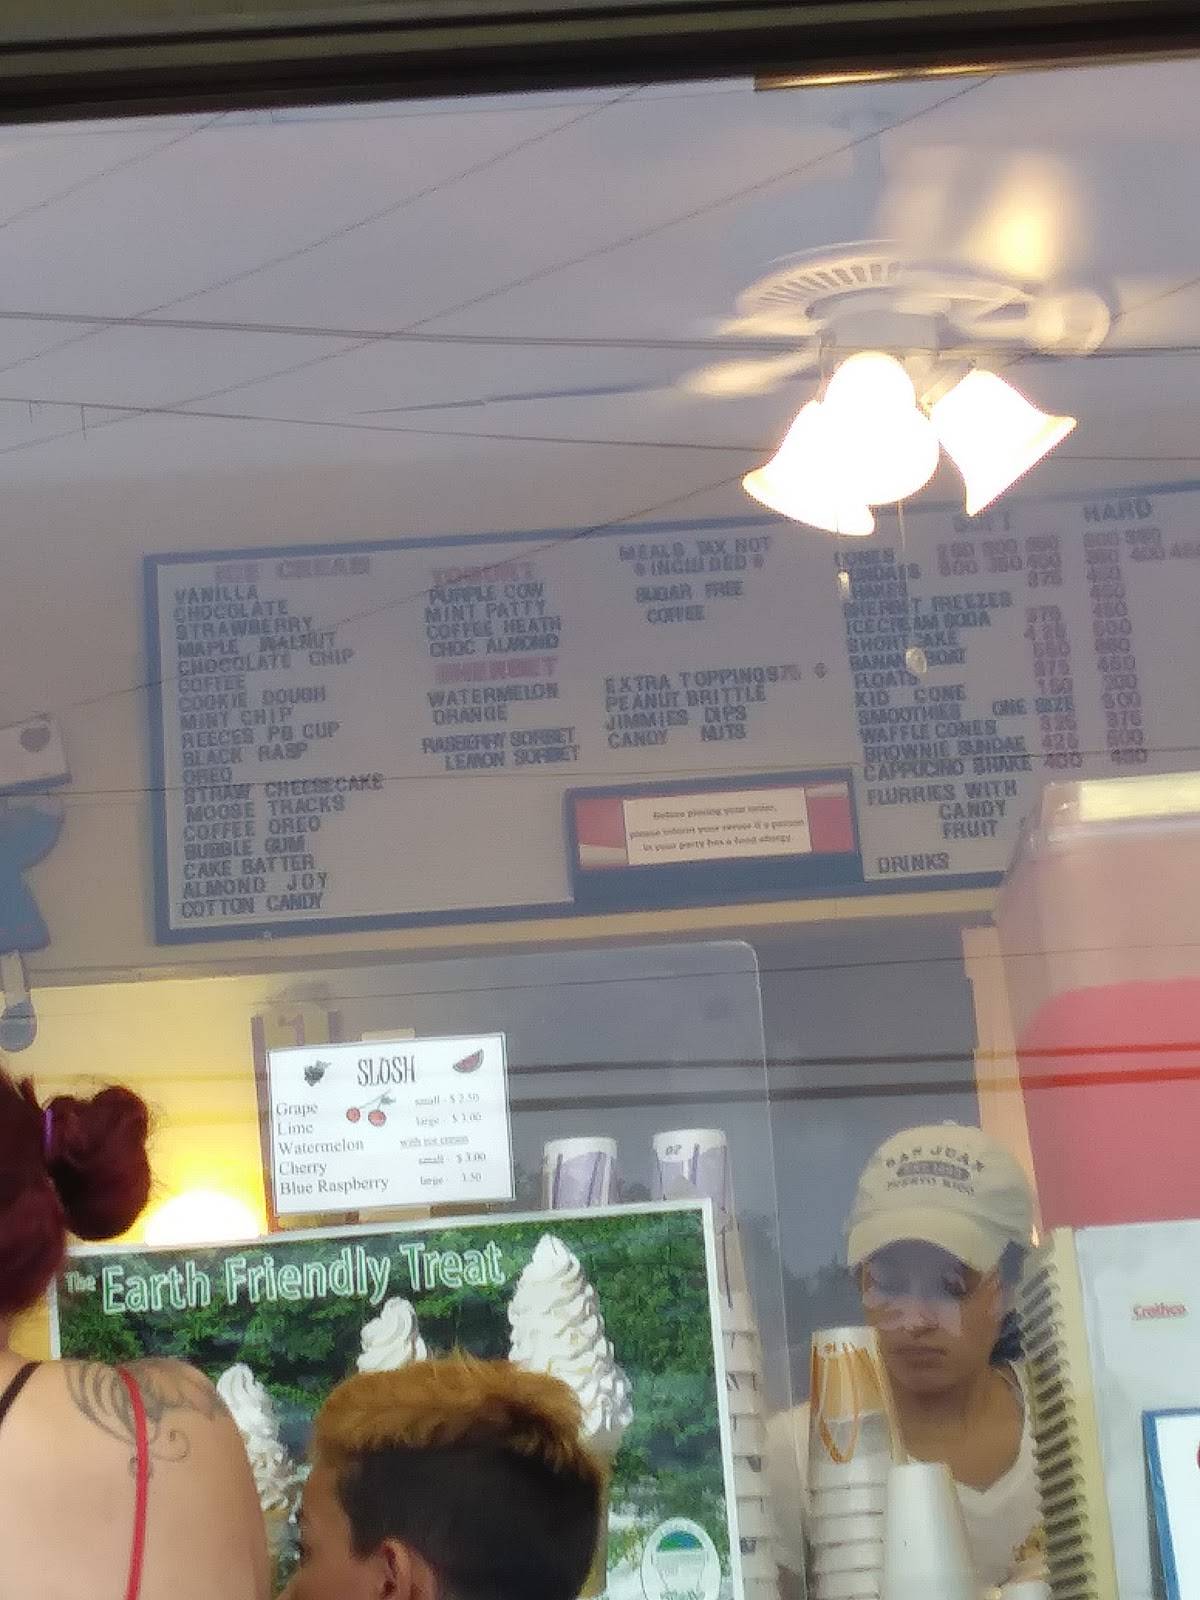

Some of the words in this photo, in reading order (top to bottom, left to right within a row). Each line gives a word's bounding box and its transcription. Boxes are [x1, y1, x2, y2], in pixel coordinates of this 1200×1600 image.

[1084, 499, 1152, 522] HARD
[174, 585, 258, 604] VANILLA
[173, 600, 288, 623] CHOCOLATE
[425, 605, 475, 624] MINT
[487, 600, 545, 618] PATTY
[175, 616, 313, 640] STRAWBERRY
[426, 622, 493, 640] COFFEE
[430, 640, 475, 657] CHOC
[177, 654, 291, 676] CHOCOLATE
[308, 648, 355, 666] CHIP
[177, 675, 246, 694] COFFEE
[604, 674, 671, 693] EXTRA
[427, 683, 558, 707] WATERMELON
[606, 691, 679, 713] PEANUT
[687, 685, 767, 707] BRITTLE
[855, 688, 889, 707] KID
[914, 684, 966, 703] CONE
[241, 707, 294, 726] CHIP
[433, 706, 508, 725] ORANGE
[303, 721, 341, 739] CUP
[860, 722, 930, 744] WAFFLE
[863, 740, 951, 763] BROWNIE
[867, 783, 956, 805] FLURRIES
[965, 779, 1018, 799] WITH
[185, 801, 256, 822] MOOSE
[267, 795, 346, 815] TRACKS
[939, 799, 1007, 820] CANDY
[183, 821, 256, 842] COFFEE
[268, 815, 321, 834] OREO
[942, 819, 999, 840] FRUIT
[184, 860, 232, 880] CAKE
[242, 854, 315, 874] BATTER
[877, 852, 950, 874] DRINKS
[184, 878, 266, 899] ALMOND
[287, 872, 329, 892] JOY
[182, 898, 255, 919] COTTON
[356, 1055, 417, 1087] SLOSH
[275, 1102, 319, 1118] Grape
[276, 1122, 314, 1136] Lime
[277, 1138, 365, 1156] Watermelon
[278, 1161, 328, 1178] Cherry
[279, 1181, 314, 1196] Blue
[317, 1176, 390, 1197] Raspberry
[102, 1260, 212, 1316] Earth
[223, 1244, 393, 1308] Friendly
[399, 1239, 506, 1293] Treat
